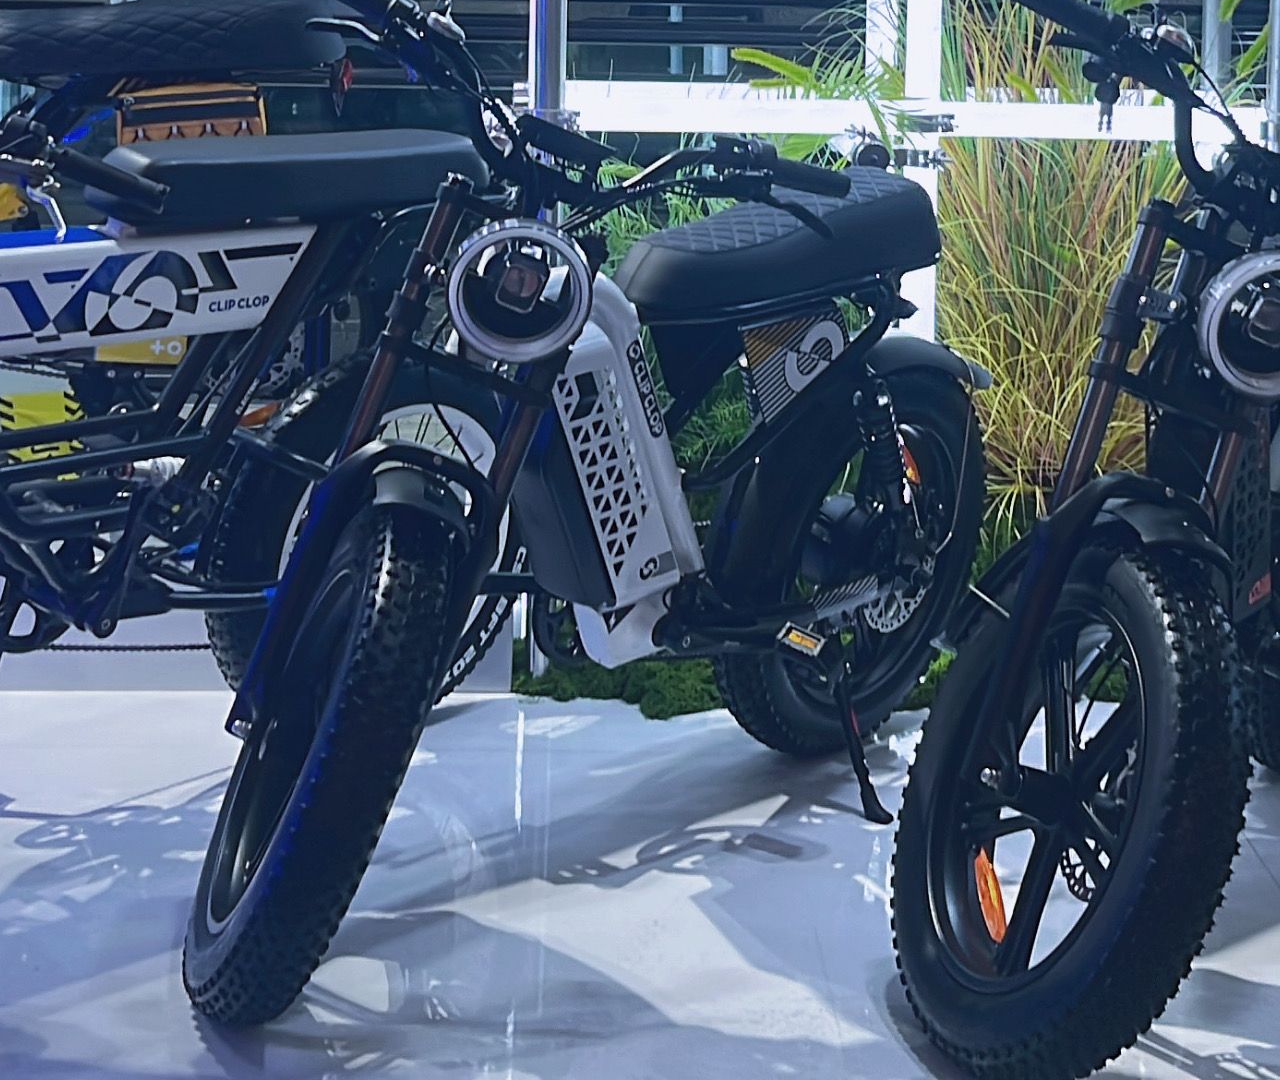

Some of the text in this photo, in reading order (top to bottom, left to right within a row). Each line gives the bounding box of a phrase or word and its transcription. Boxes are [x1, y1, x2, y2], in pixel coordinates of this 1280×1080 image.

[208, 295, 270, 312] CLIP CLOP
[634, 360, 663, 435] CLIP CLOP
